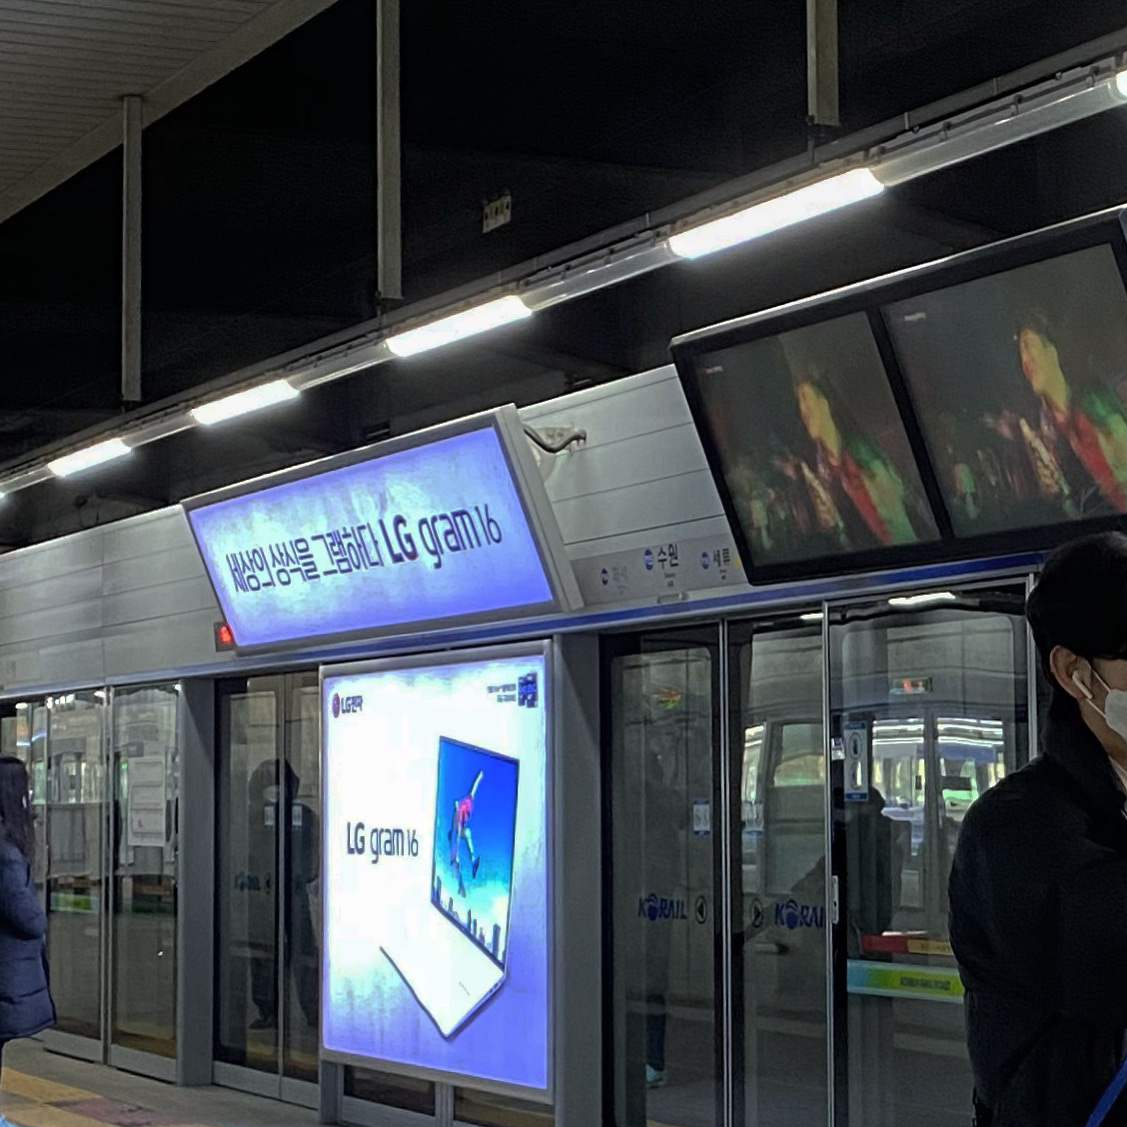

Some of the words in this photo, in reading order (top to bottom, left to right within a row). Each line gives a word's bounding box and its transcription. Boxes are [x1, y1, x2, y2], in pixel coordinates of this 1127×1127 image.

[226, 547, 274, 592] 세상의
[269, 537, 320, 585] 상식을
[311, 522, 385, 576] 그램하다
[379, 514, 419, 563] LG
[418, 508, 482, 569] gram
[474, 504, 502, 546] 16
[657, 543, 679, 570] 수원
[347, 822, 365, 855] LG
[370, 828, 404, 864] gram
[407, 829, 419, 856] 16
[638, 893, 688, 922] KORAIL
[774, 899, 826, 930] KORAI
